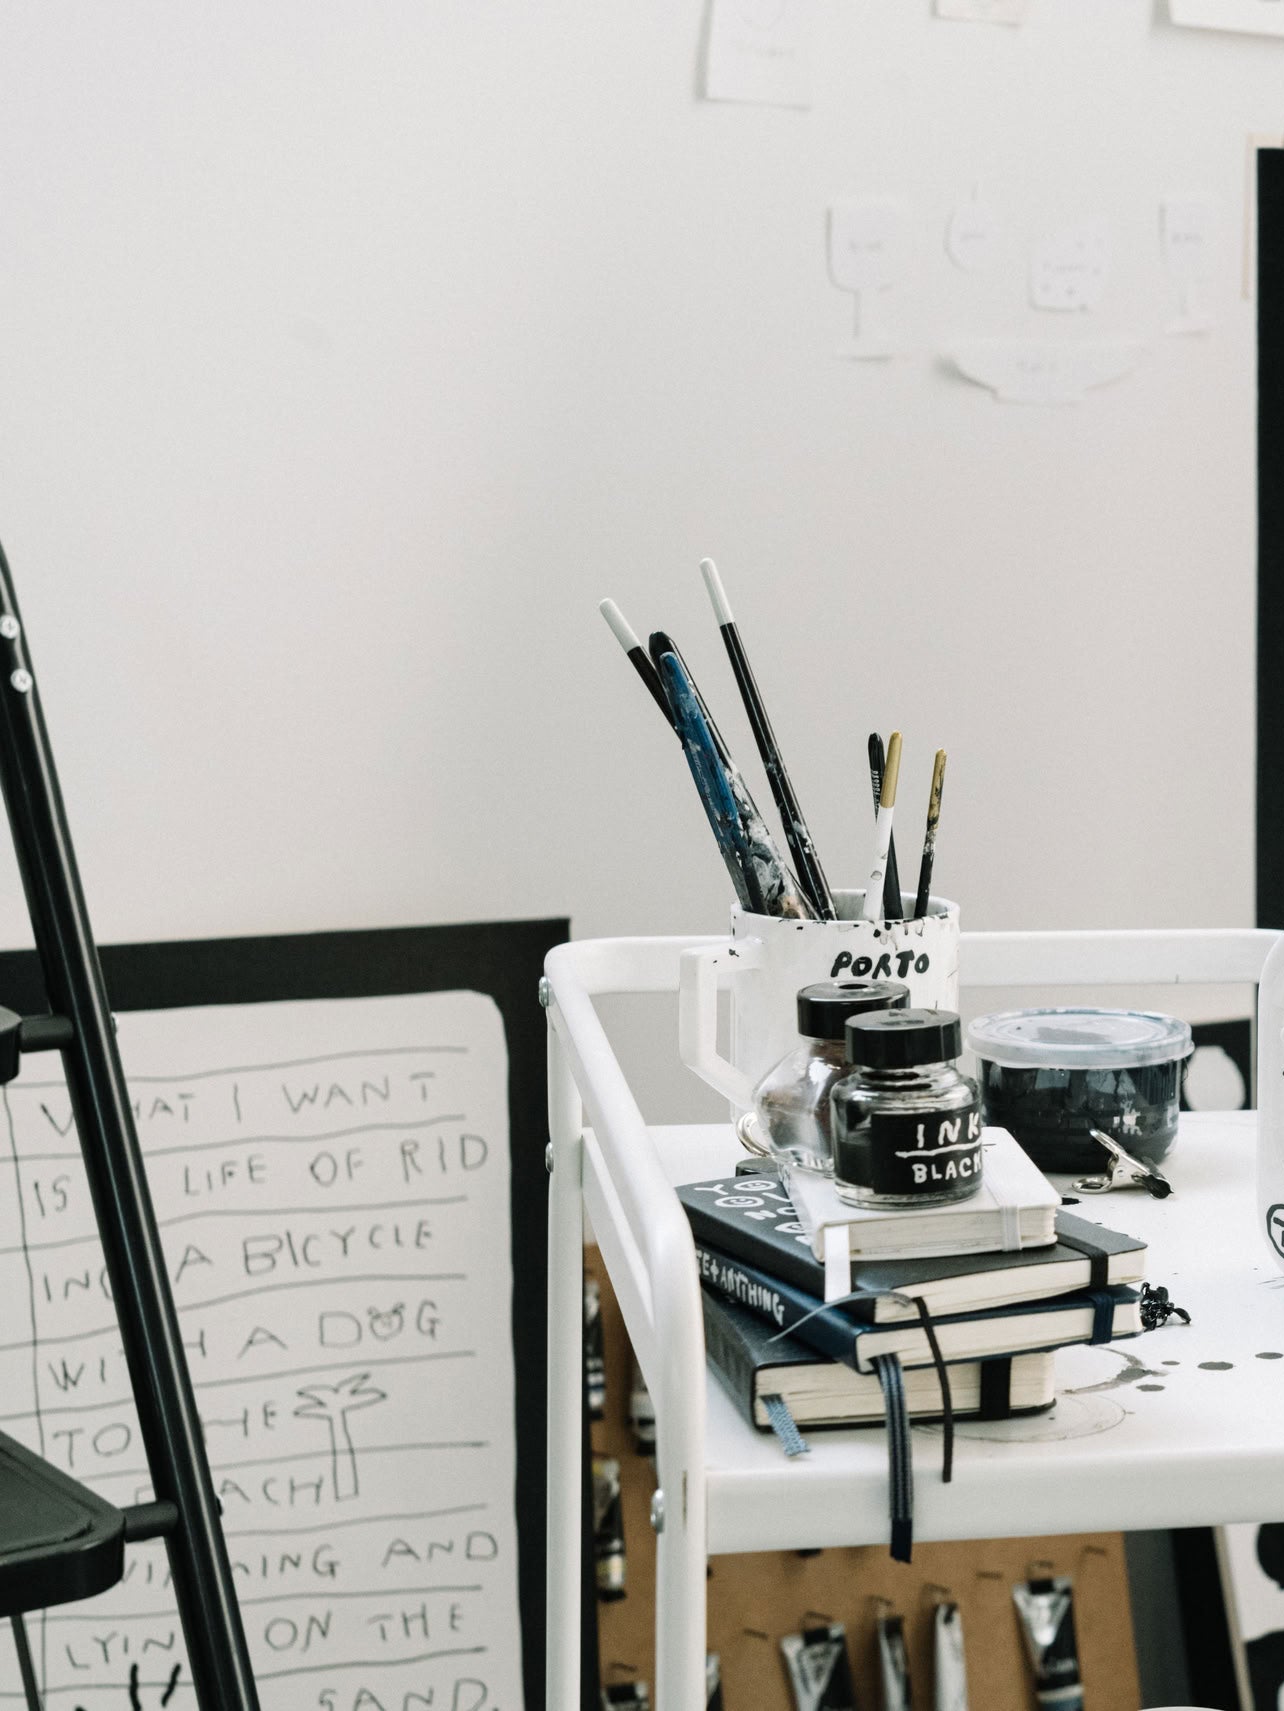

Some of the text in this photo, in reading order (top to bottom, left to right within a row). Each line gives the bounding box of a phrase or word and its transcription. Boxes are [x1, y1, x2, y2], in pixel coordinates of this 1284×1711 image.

[830, 949, 930, 979] PORTO
[233, 1083, 242, 1123] I
[282, 1073, 436, 1115] WANT
[917, 1112, 979, 1148] INK
[34, 1134, 489, 1219] IS LIFE OF RID
[176, 1245, 213, 1284] A
[243, 1220, 433, 1276] BICYCLE
[238, 1327, 288, 1359] A
[53, 1423, 131, 1469] TO
[382, 1531, 498, 1567] AND
[265, 1609, 333, 1653] ON
[367, 1603, 465, 1641] THE
